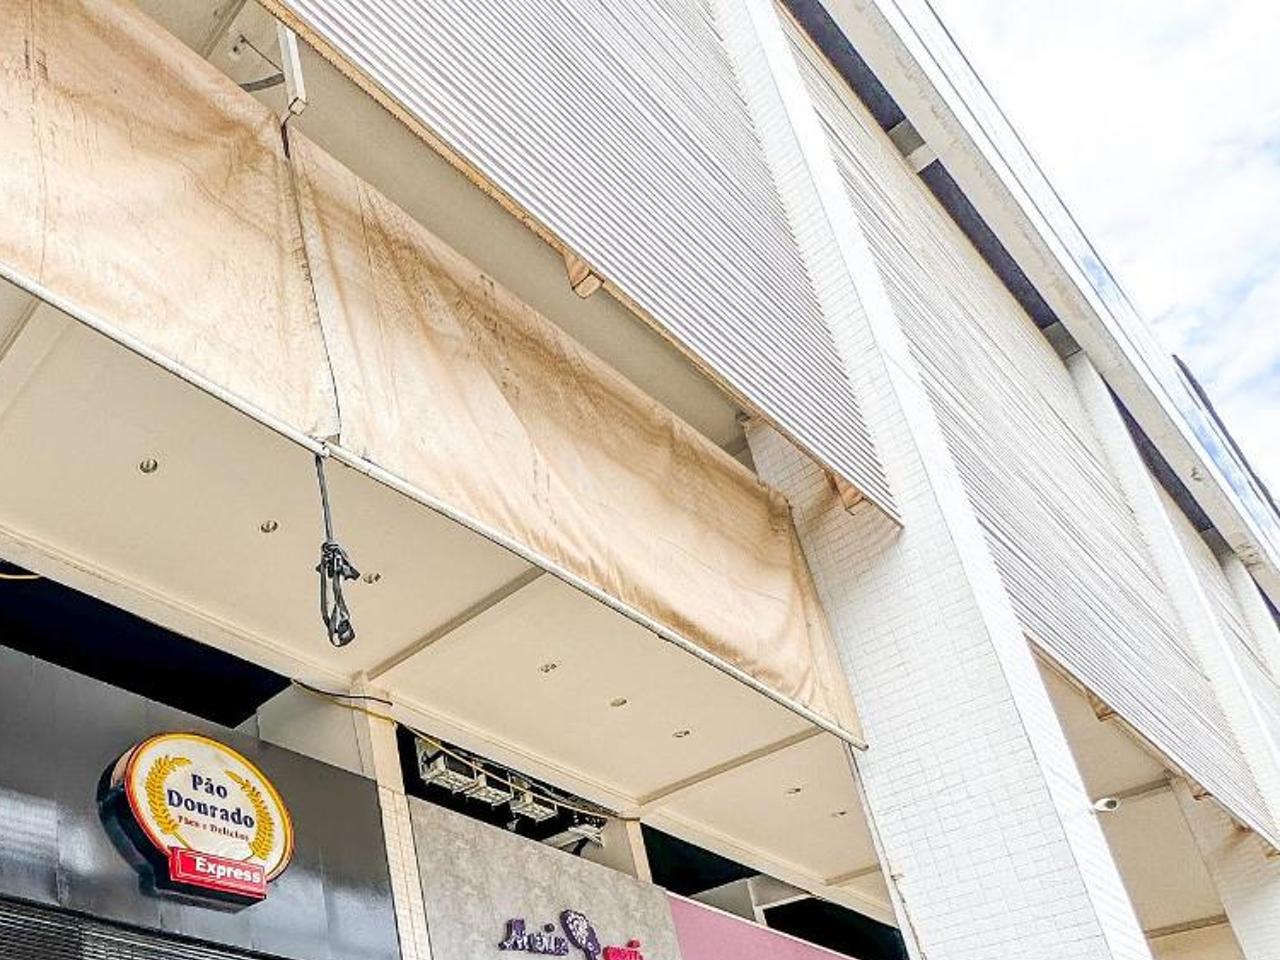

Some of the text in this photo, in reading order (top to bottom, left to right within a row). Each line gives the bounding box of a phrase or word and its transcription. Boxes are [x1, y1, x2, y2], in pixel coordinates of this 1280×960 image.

[191, 773, 228, 800] Pão
[167, 789, 256, 829] Dourado
[195, 857, 262, 884] Express
